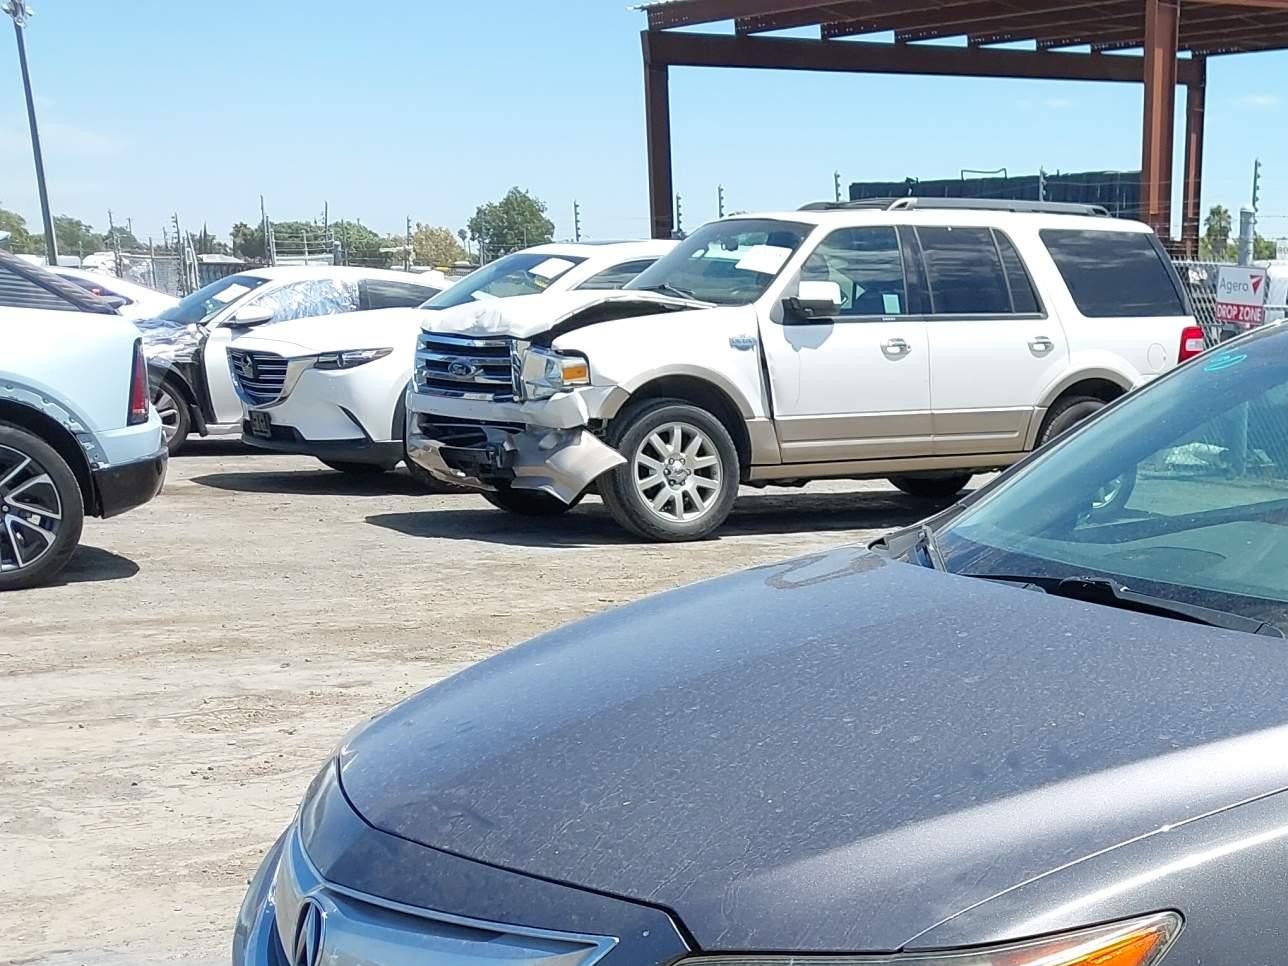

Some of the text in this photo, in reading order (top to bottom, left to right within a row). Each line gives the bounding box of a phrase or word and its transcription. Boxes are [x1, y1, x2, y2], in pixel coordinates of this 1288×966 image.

[1220, 278, 1248, 293] Agero
[1217, 305, 1262, 321] DROP ZONE
